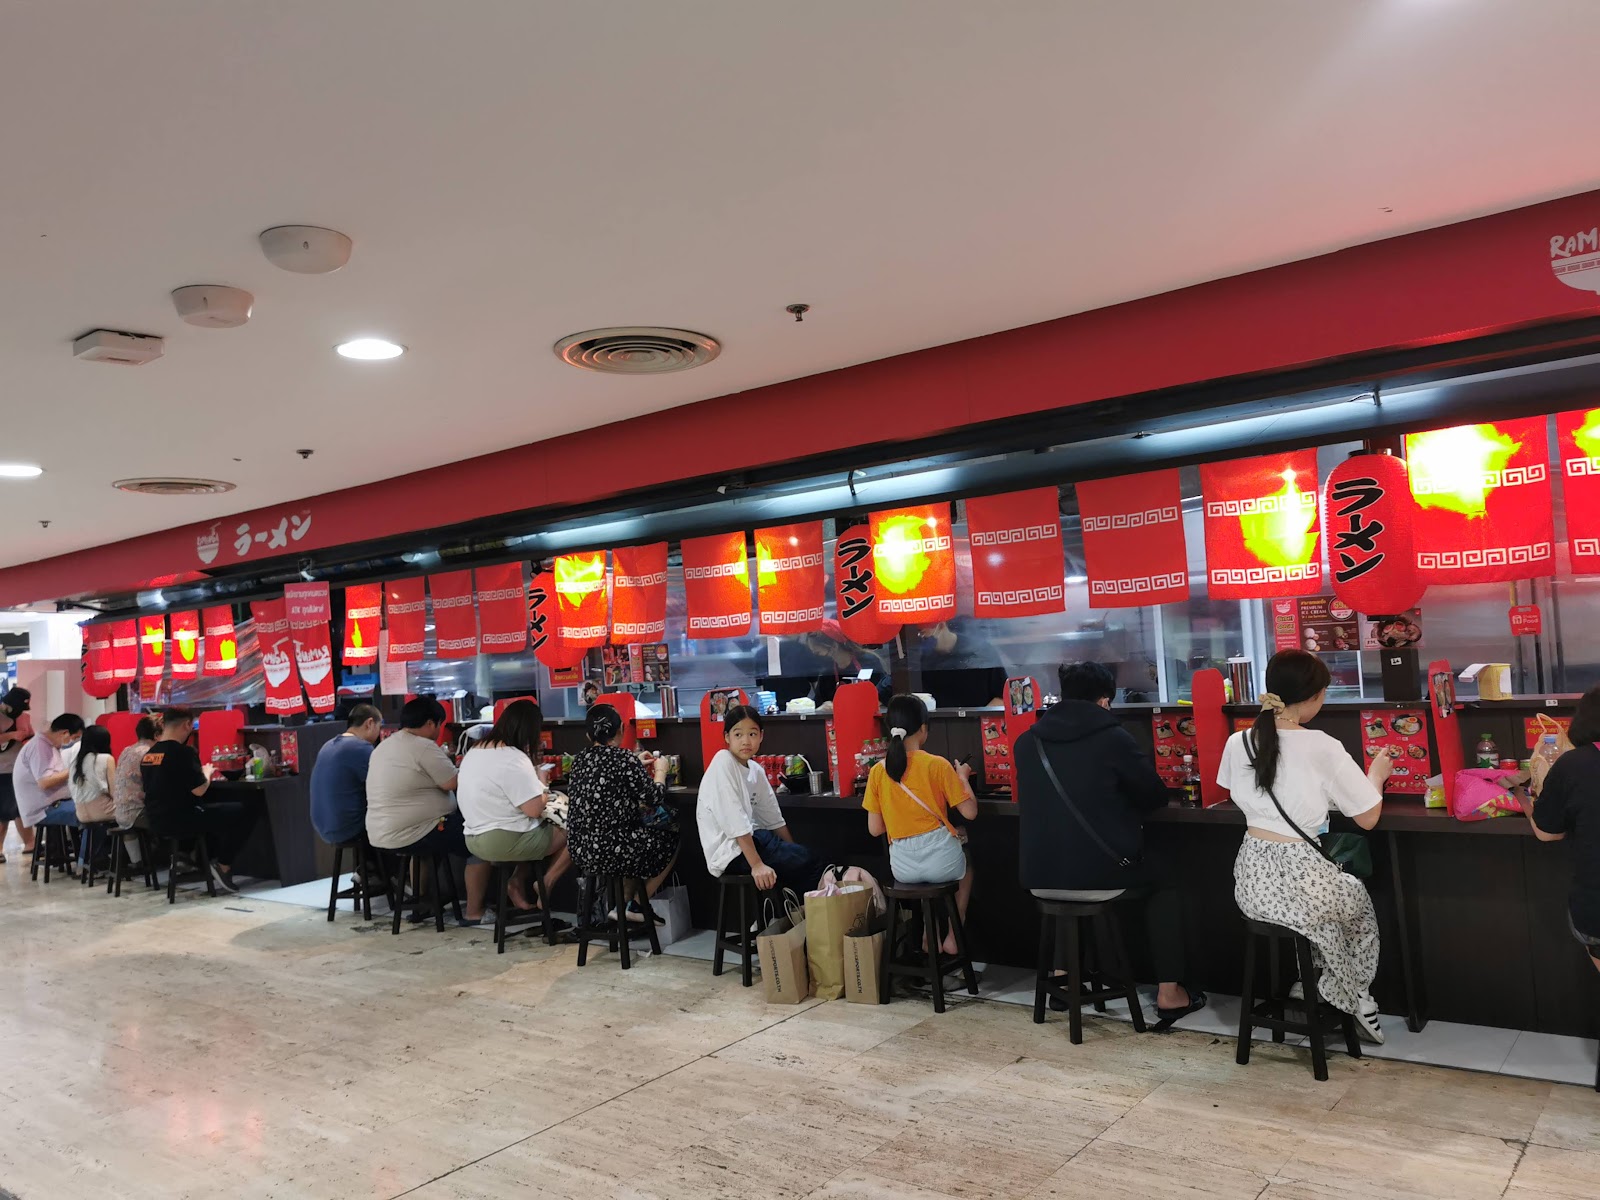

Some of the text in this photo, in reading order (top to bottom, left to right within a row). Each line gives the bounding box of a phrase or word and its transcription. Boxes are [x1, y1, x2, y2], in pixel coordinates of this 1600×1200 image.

[1549, 227, 1600, 258] RAM
[234, 514, 312, 556] ラーメン
[1332, 477, 1385, 583] ラーメン
[837, 538, 875, 619] ラーメン
